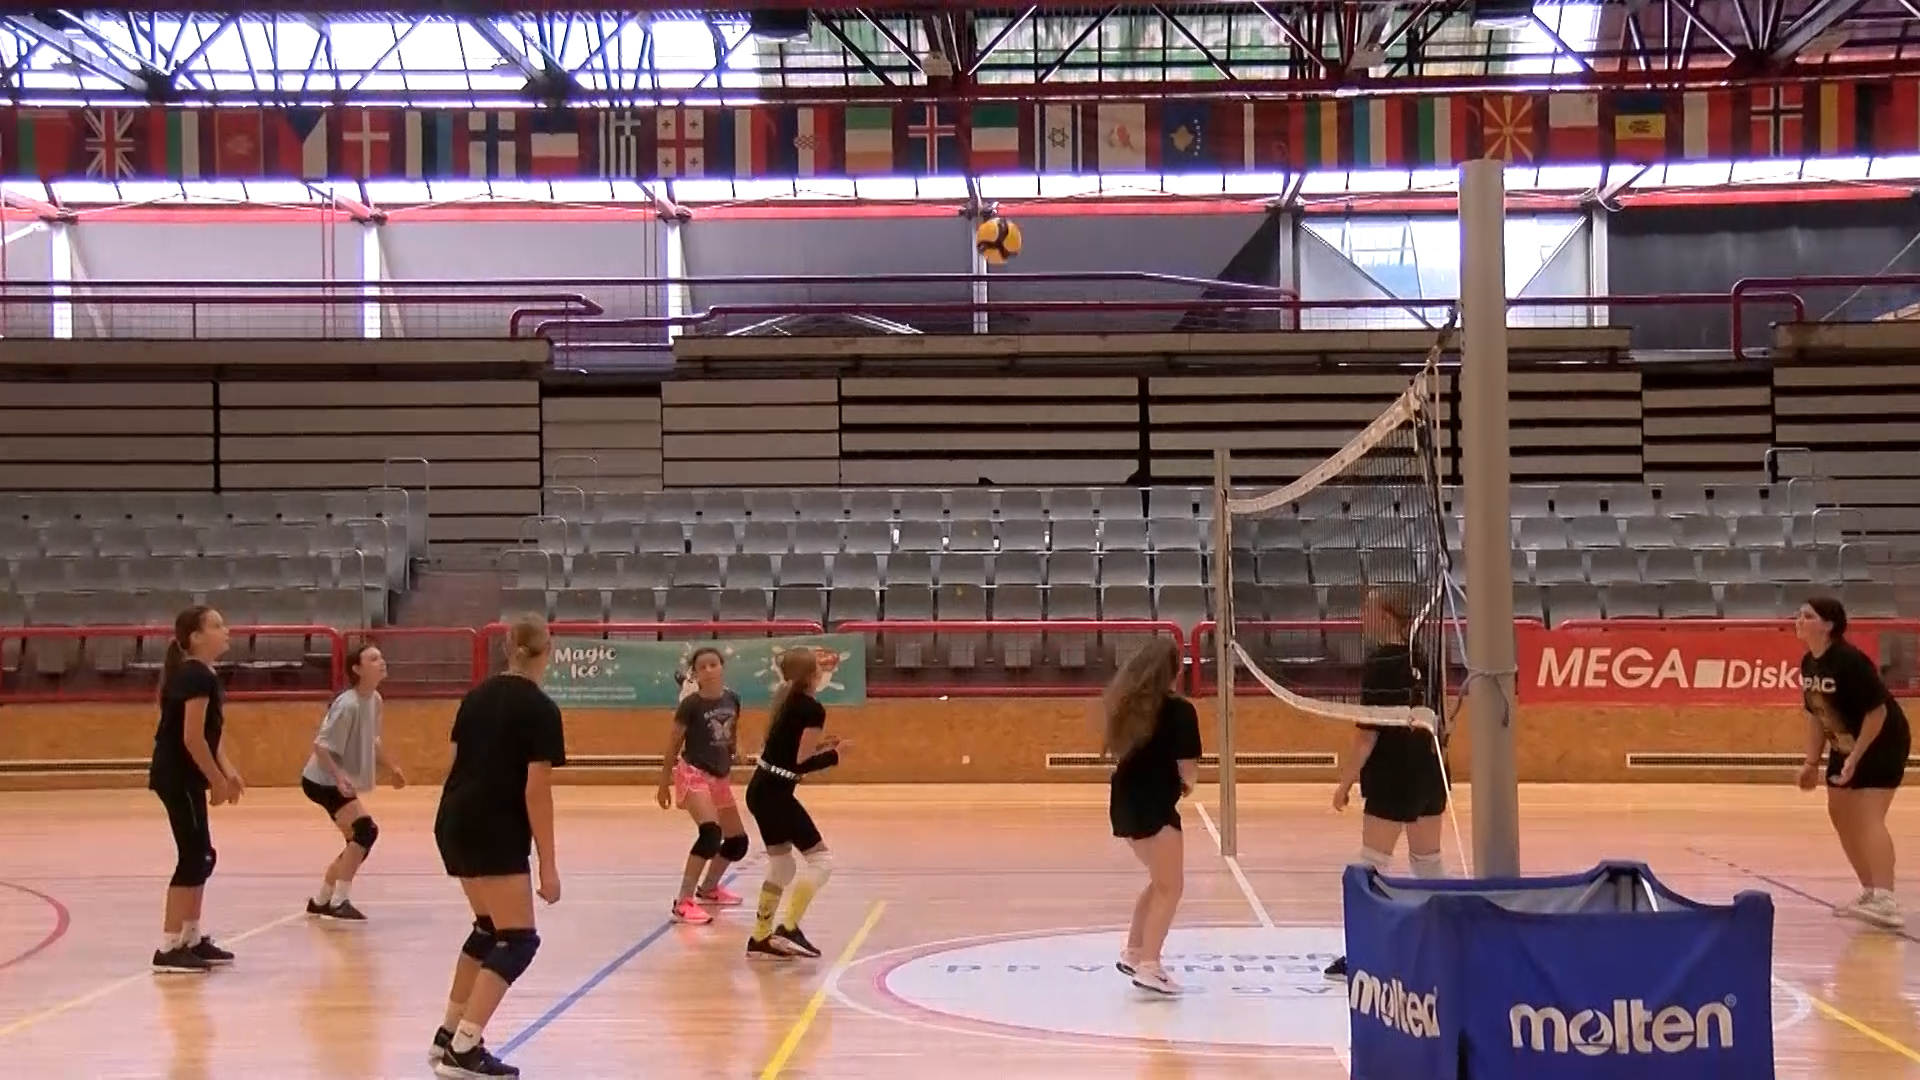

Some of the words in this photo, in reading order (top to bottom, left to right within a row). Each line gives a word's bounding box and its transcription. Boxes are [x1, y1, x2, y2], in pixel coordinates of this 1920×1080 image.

[555, 645, 617, 664] Magic
[571, 663, 600, 678] Ice
[1537, 646, 1690, 689] MEGA
[1350, 969, 1441, 1038] molten
[1509, 998, 1734, 1056] molten
